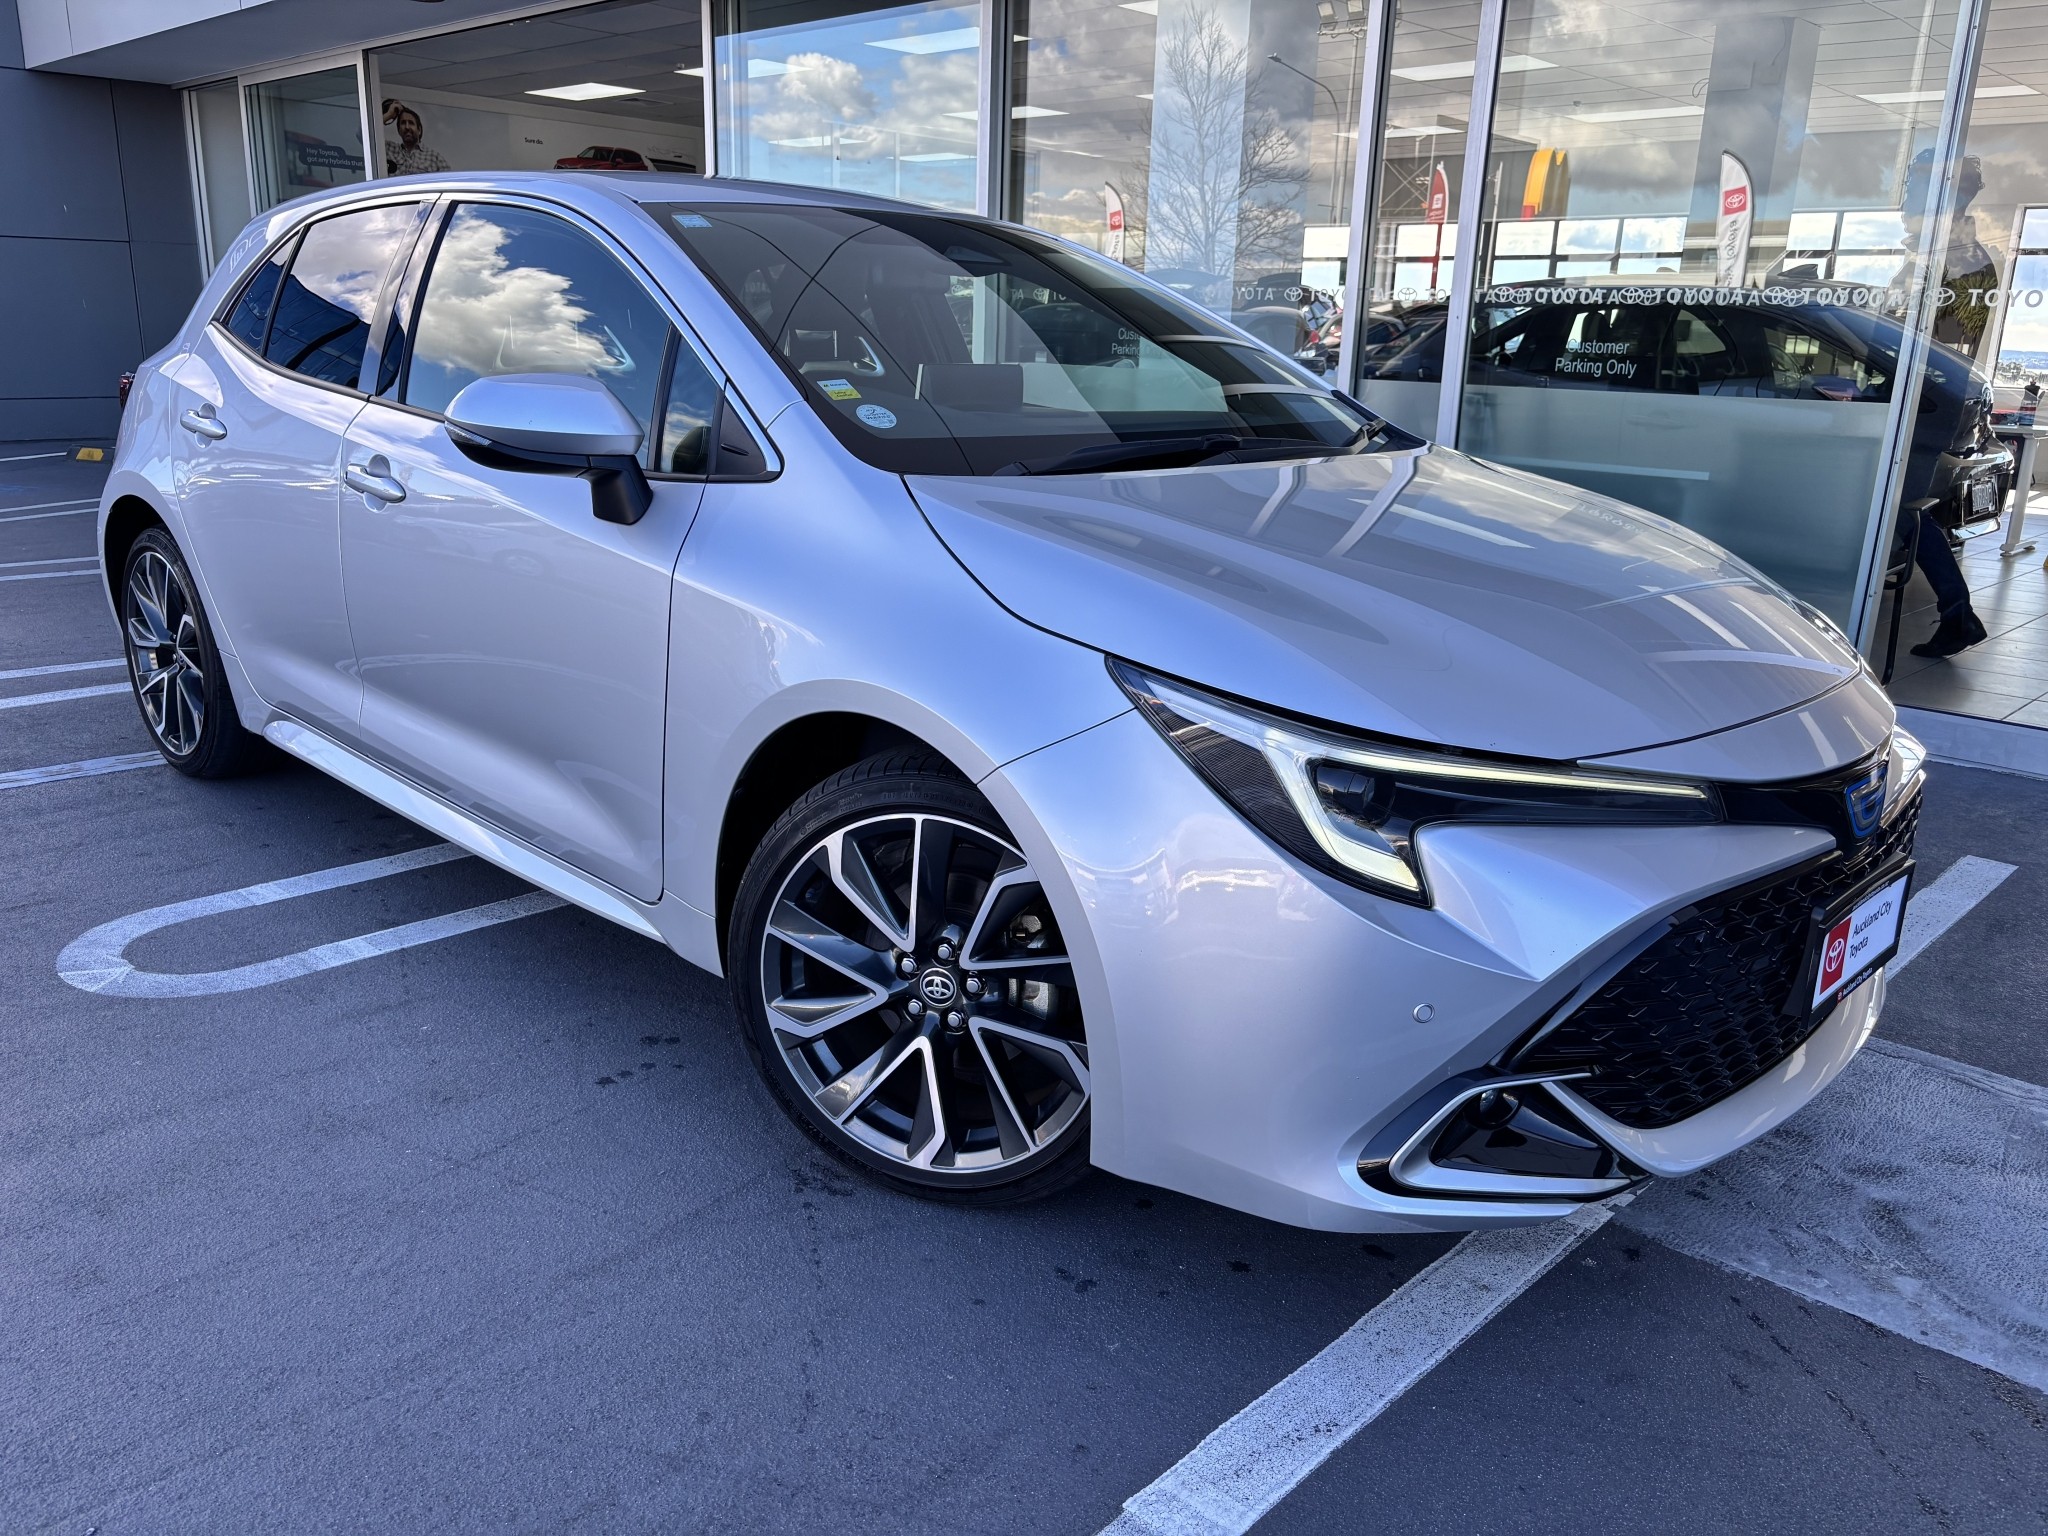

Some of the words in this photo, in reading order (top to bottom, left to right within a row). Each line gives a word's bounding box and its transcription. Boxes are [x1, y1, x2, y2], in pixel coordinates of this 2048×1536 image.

[306, 148, 318, 156] Hey
[330, 158, 351, 166] hybrids
[1567, 338, 1630, 354] Customer
[1555, 357, 1603, 378] Parking
[1606, 359, 1637, 379] Only
[1852, 906, 1881, 939] Auckland
[1880, 900, 1893, 917] City
[1849, 936, 1869, 958] Toyota
[1843, 977, 1857, 997] Auckland
